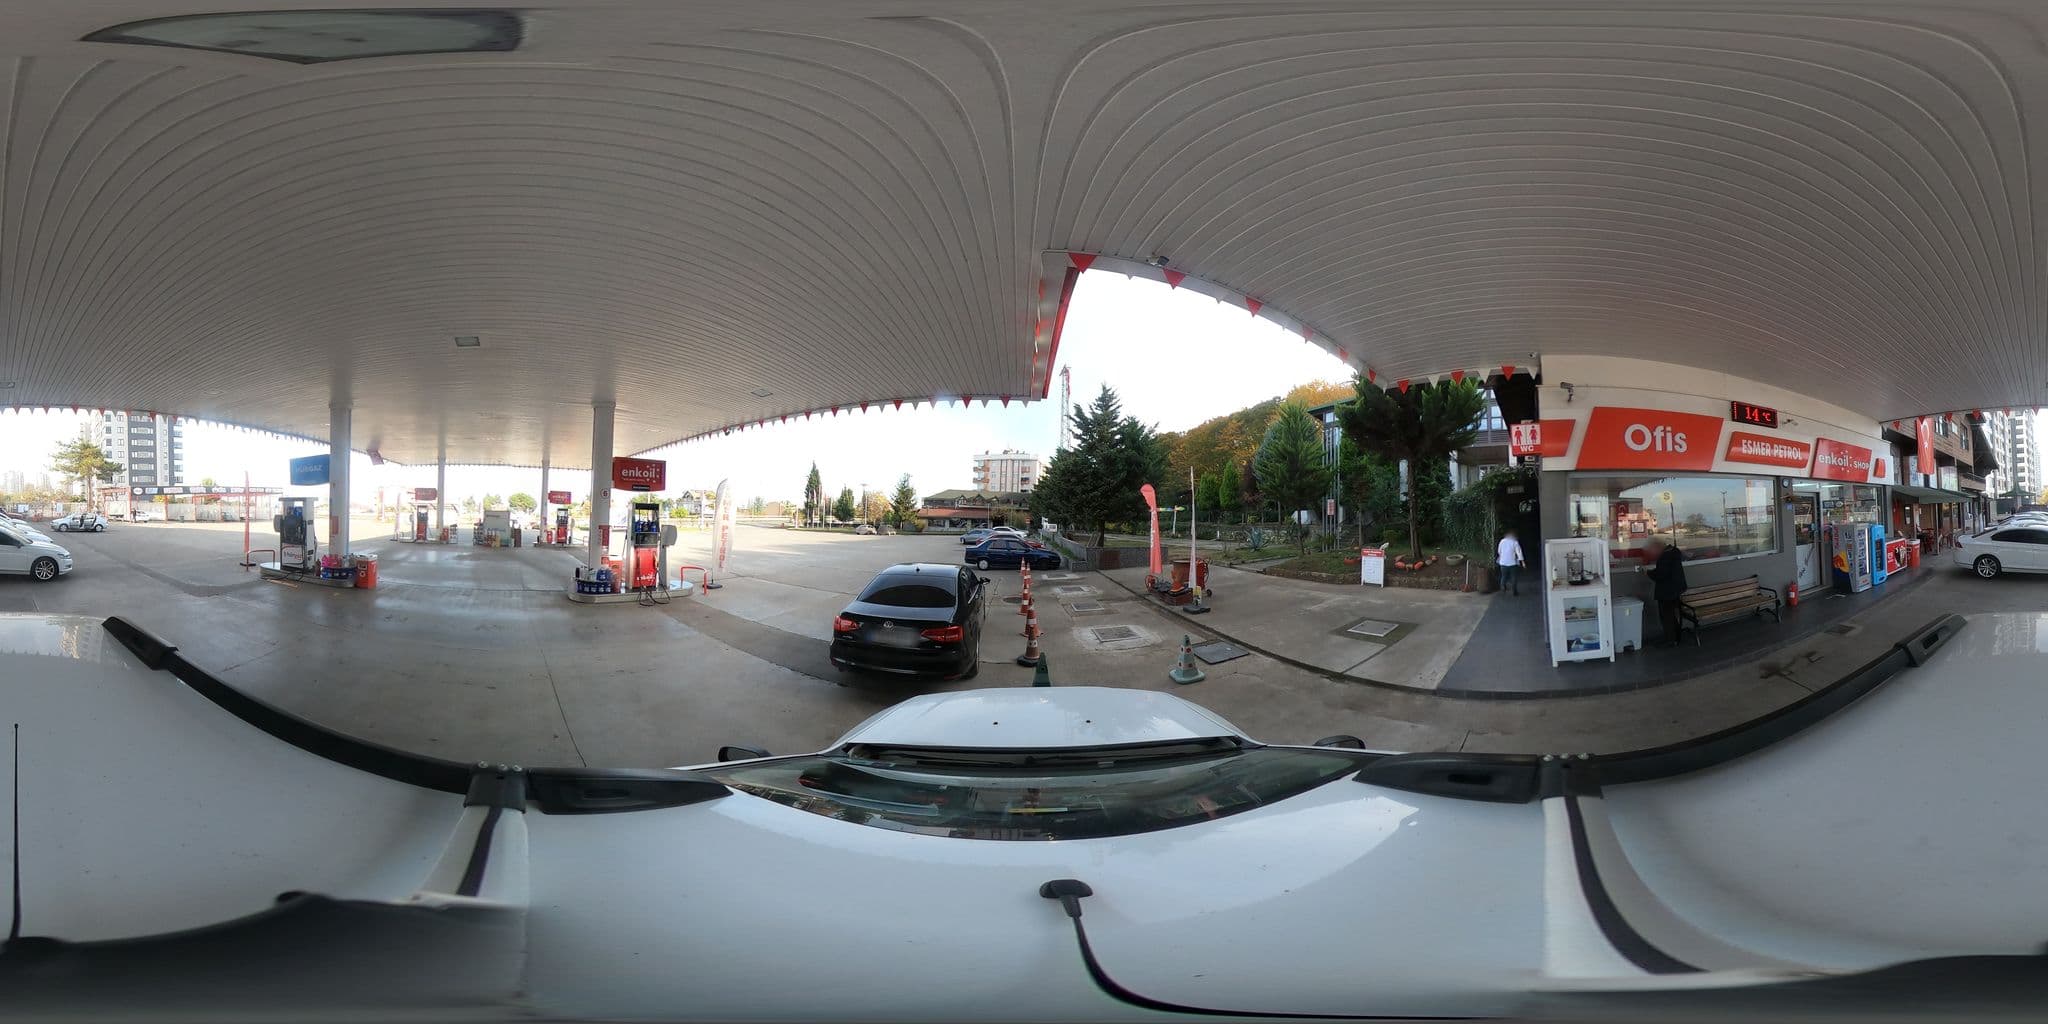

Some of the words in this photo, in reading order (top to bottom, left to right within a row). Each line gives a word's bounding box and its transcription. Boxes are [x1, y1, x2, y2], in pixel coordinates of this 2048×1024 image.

[1745, 406, 1760, 422] 14
[1624, 423, 1688, 453] Ofis
[1742, 439, 1772, 457] ESMER
[1773, 443, 1803, 461] PETROL
[1818, 452, 1848, 466] enkoil
[1853, 460, 1870, 471] SHOP
[621, 467, 656, 478] enkoil
